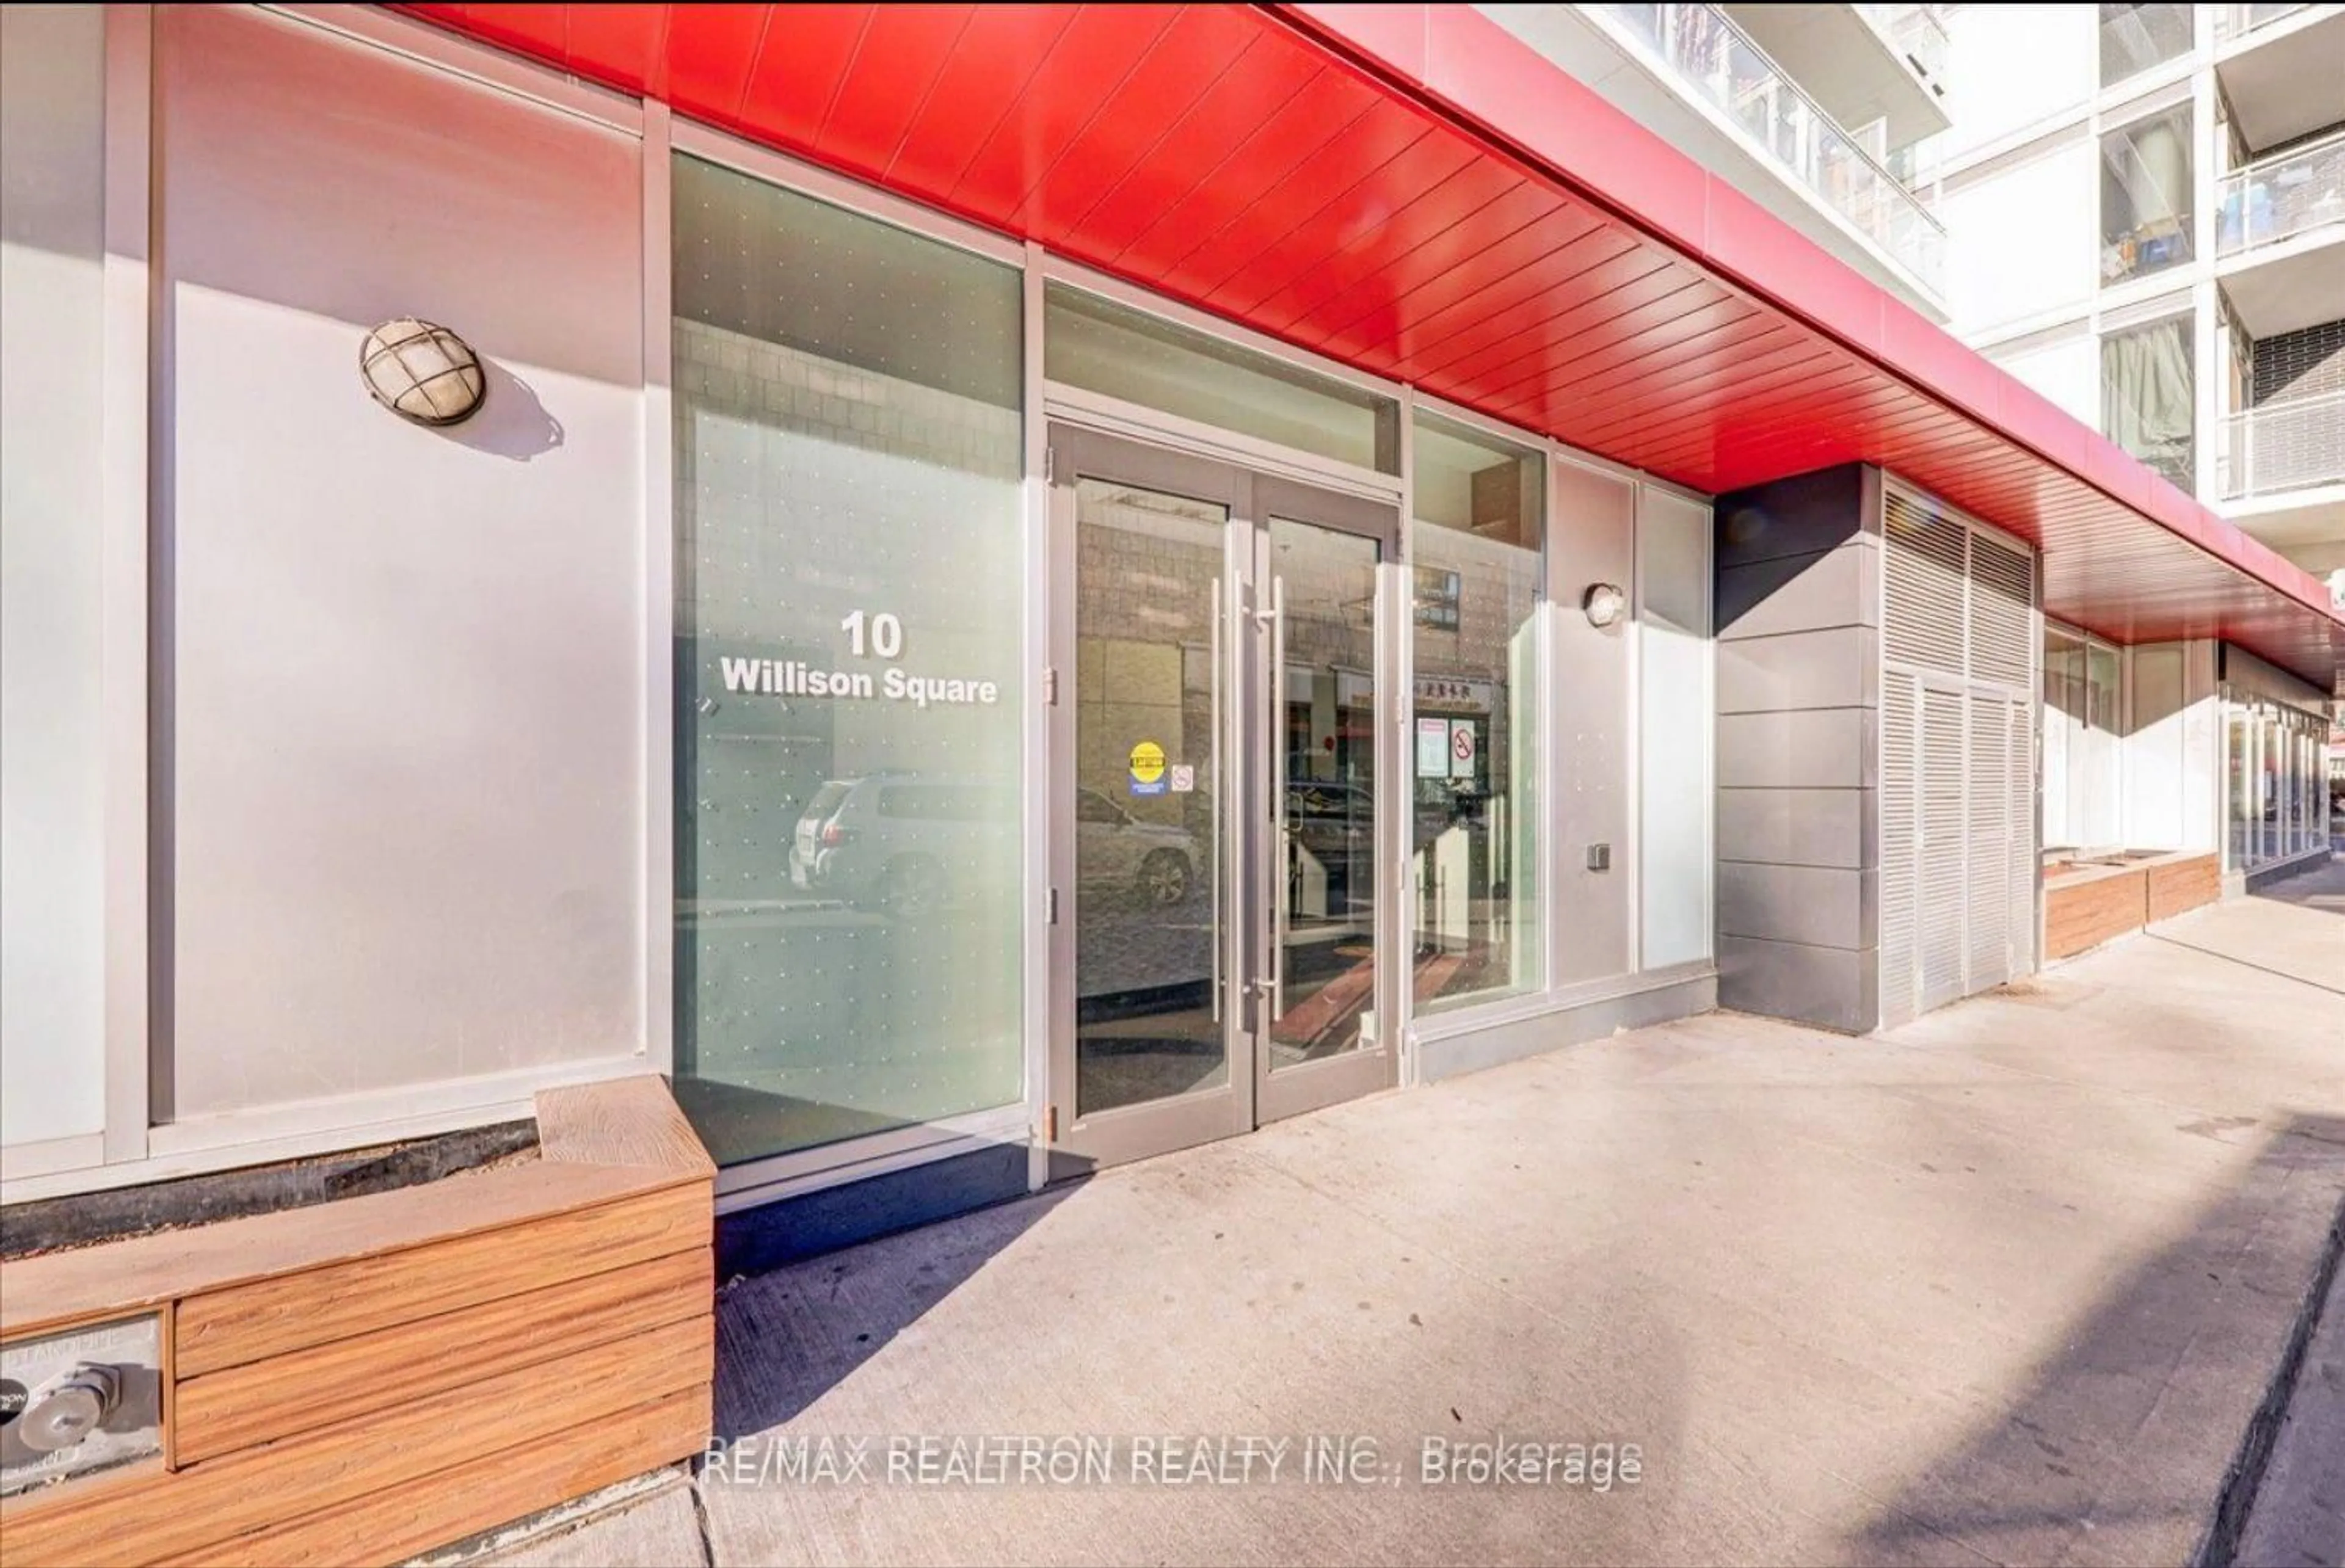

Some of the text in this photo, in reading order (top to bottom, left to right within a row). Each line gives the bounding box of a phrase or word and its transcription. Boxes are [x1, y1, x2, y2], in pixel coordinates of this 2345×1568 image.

[842, 611, 901, 658] 10
[721, 656, 997, 707] Willison Square
